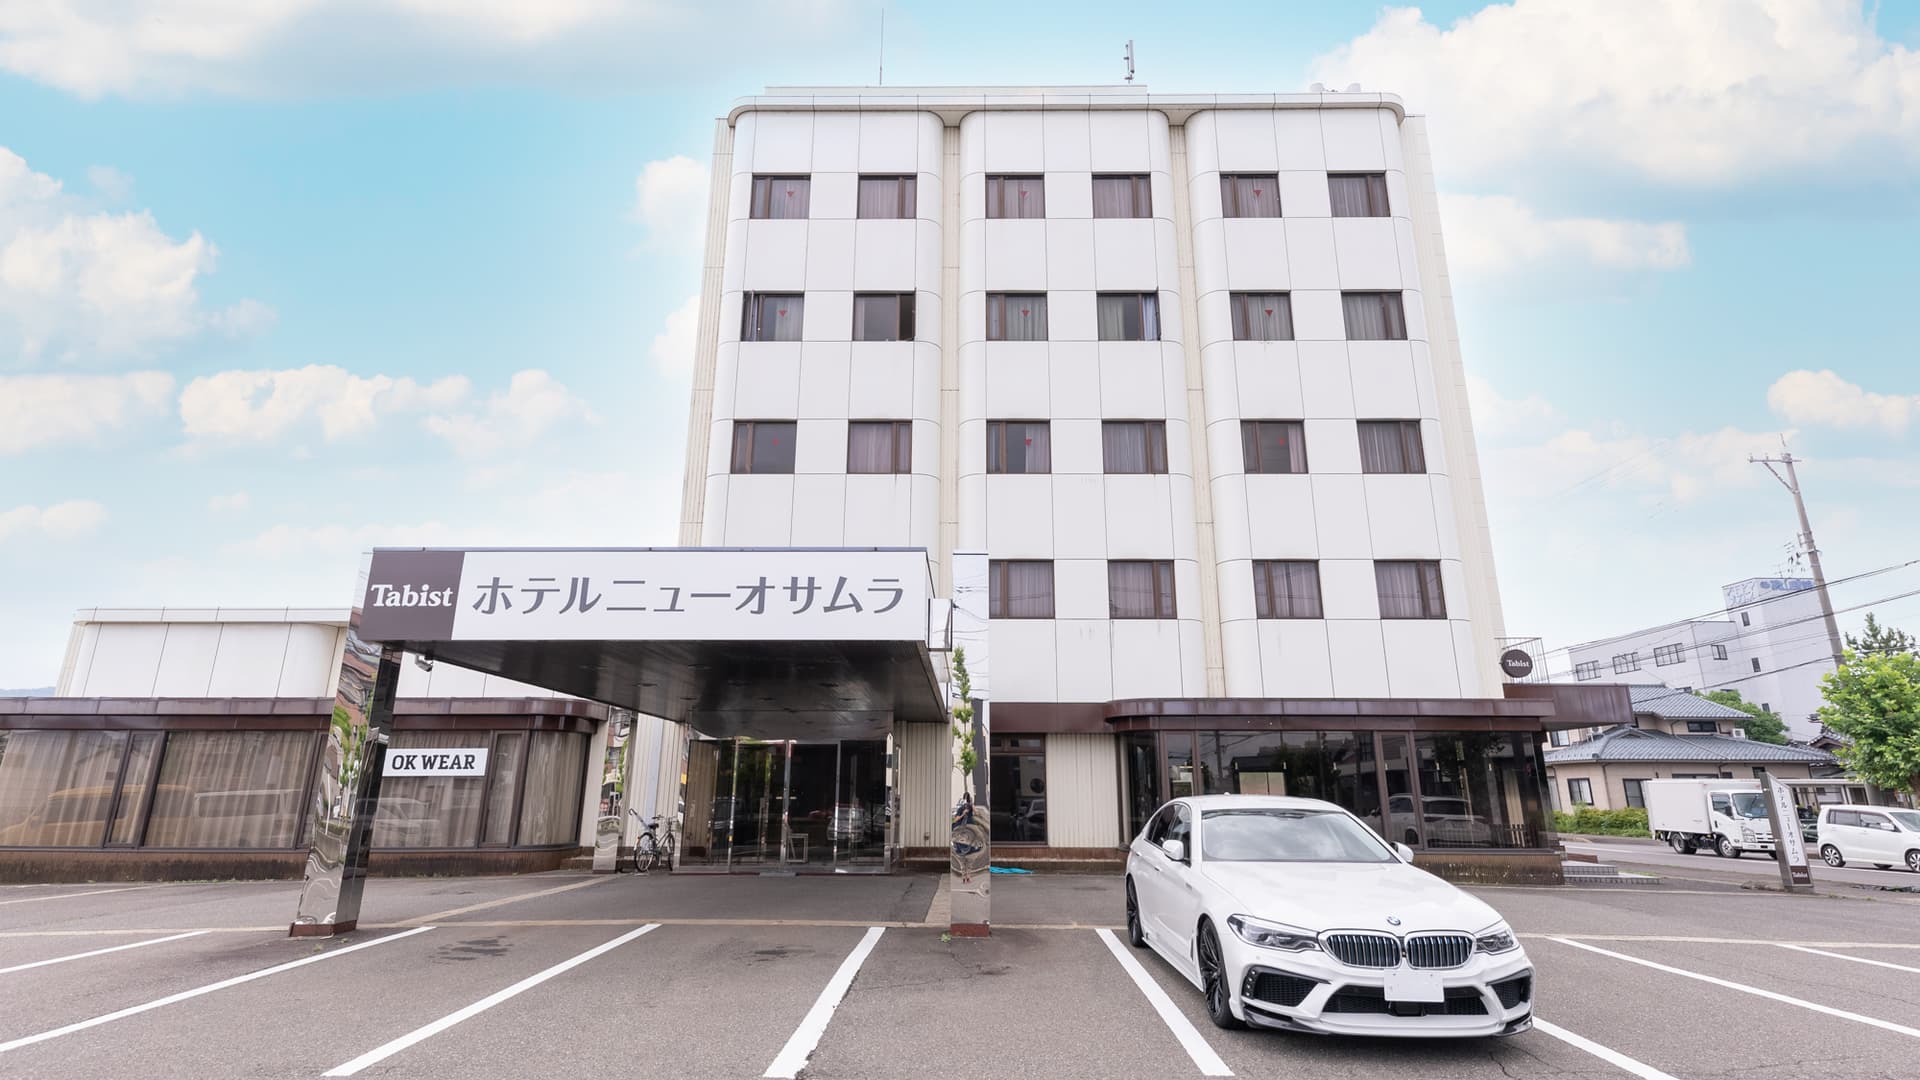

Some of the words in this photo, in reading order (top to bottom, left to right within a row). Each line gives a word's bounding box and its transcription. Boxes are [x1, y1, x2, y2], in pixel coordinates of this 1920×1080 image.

[370, 583, 454, 607] Tabist
[473, 576, 904, 615] ホテルニューオサムラ
[1506, 659, 1530, 668] Tabist
[391, 754, 418, 770] OK
[421, 754, 476, 770] WEAR
